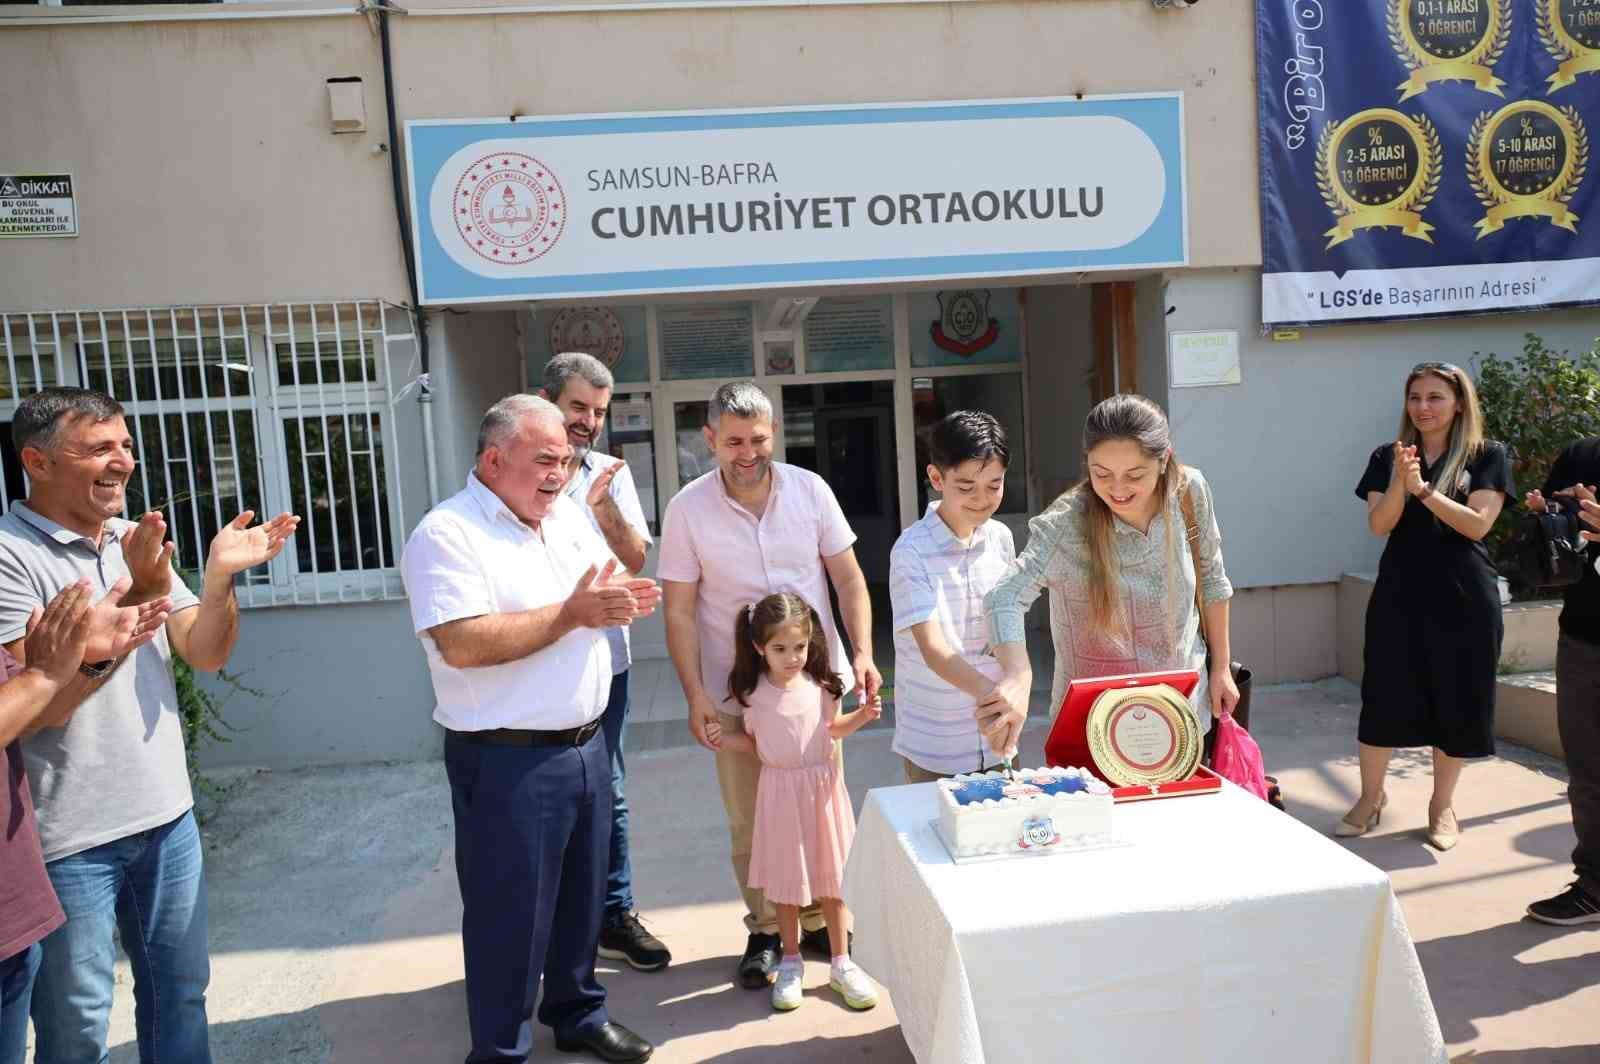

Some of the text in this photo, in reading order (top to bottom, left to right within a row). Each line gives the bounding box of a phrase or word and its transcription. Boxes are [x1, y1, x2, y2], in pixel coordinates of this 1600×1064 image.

[1446, 0, 1479, 14] ARASI
[1418, 22, 1425, 36] 3
[1368, 127, 1383, 145] %
[1520, 117, 1533, 136] %
[1346, 144, 1405, 163] 2-5 ARASI
[1498, 135, 1556, 153] 5-10 ARASI
[1341, 162, 1407, 184] 13 ÖĞRENCİ
[1496, 154, 1556, 174] 17 ÖĞRENCİ
[586, 161, 778, 192] SAMSUN-BAFRA
[20, 179, 70, 195] DİKKAT!
[16, 199, 40, 207] OKUL
[590, 186, 1104, 240] CUMHURİYET ORTAOKULU
[1389, 284, 1474, 307] Başarının
[1480, 278, 1537, 298] Adresi
